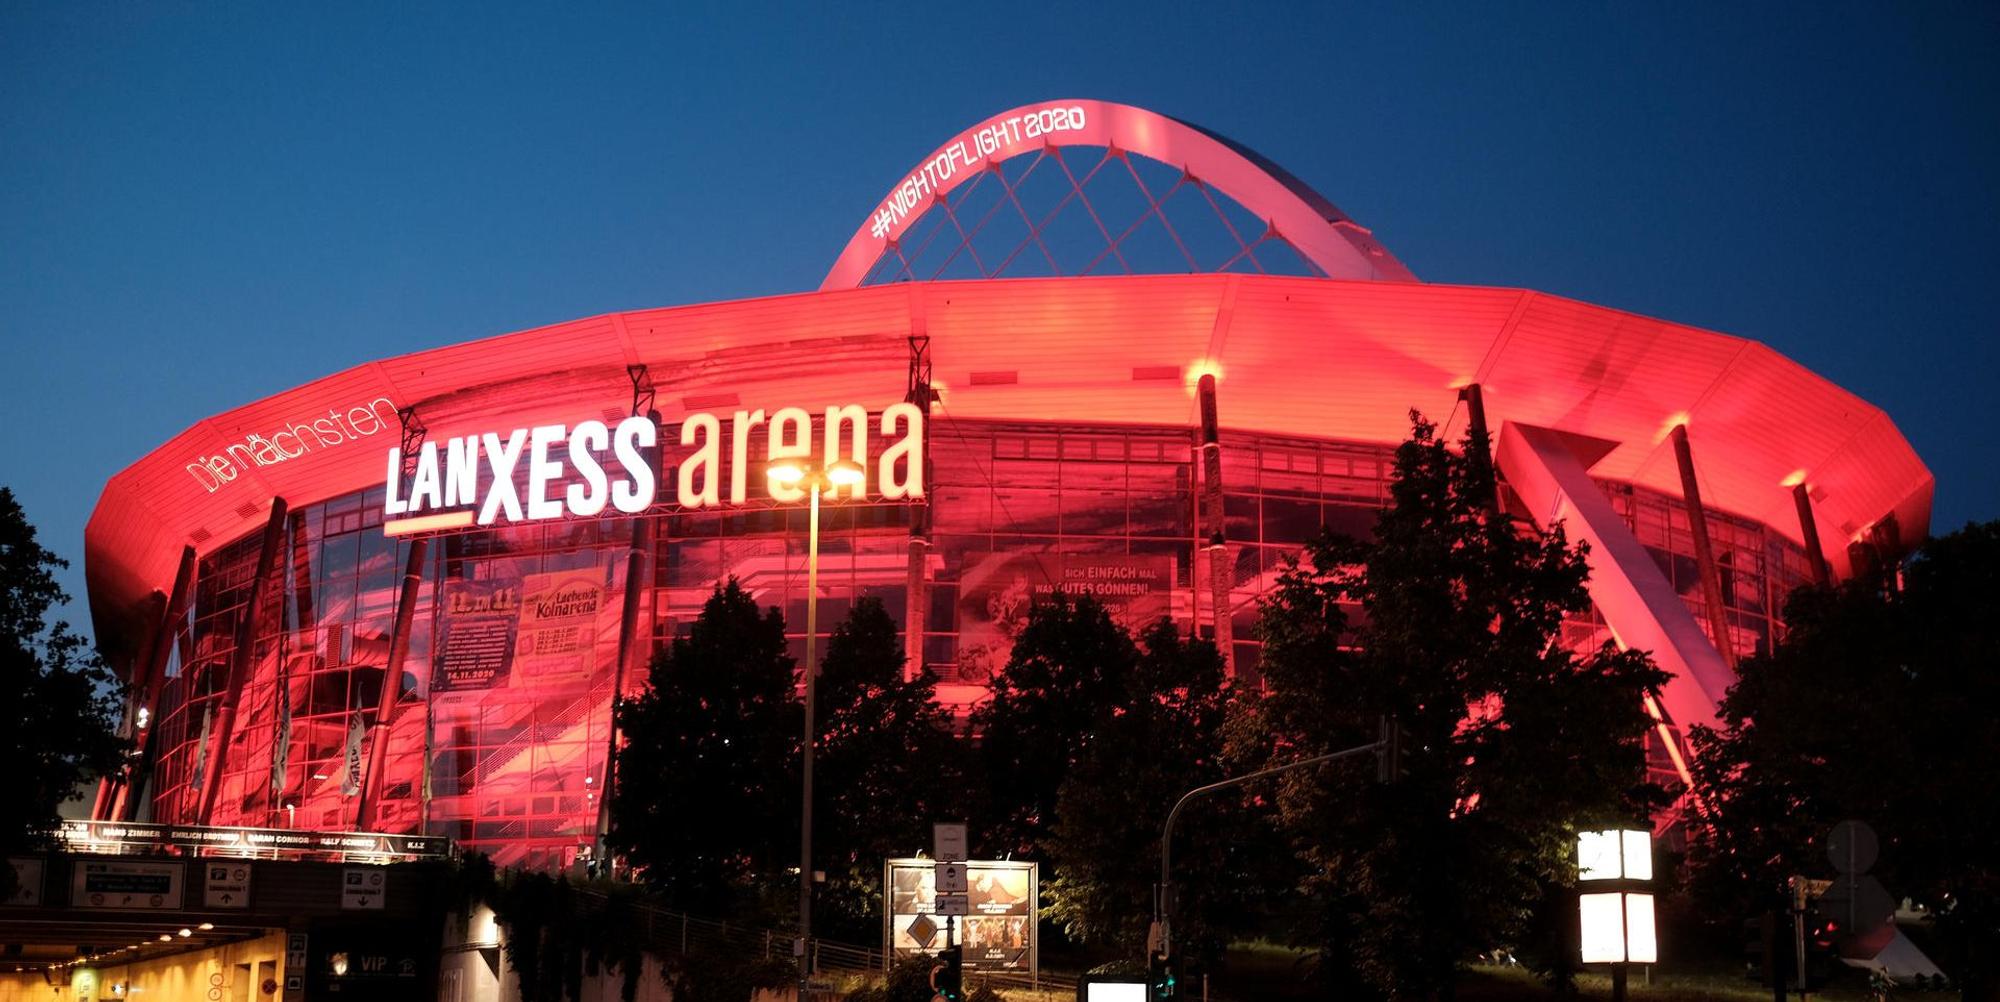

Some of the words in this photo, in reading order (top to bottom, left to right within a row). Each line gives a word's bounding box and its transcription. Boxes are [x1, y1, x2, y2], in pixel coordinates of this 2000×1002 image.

[871, 106, 1086, 239] #NIGHTOFLIGHT2020
[384, 415, 657, 526] LANXESS
[678, 402, 926, 509] arena
[1087, 567, 1136, 579] EINFACH
[1035, 583, 1054, 594] WAS
[128, 829, 161, 839] ZIMMER
[276, 835, 309, 845] CONNOR
[360, 954, 387, 972] VIP
